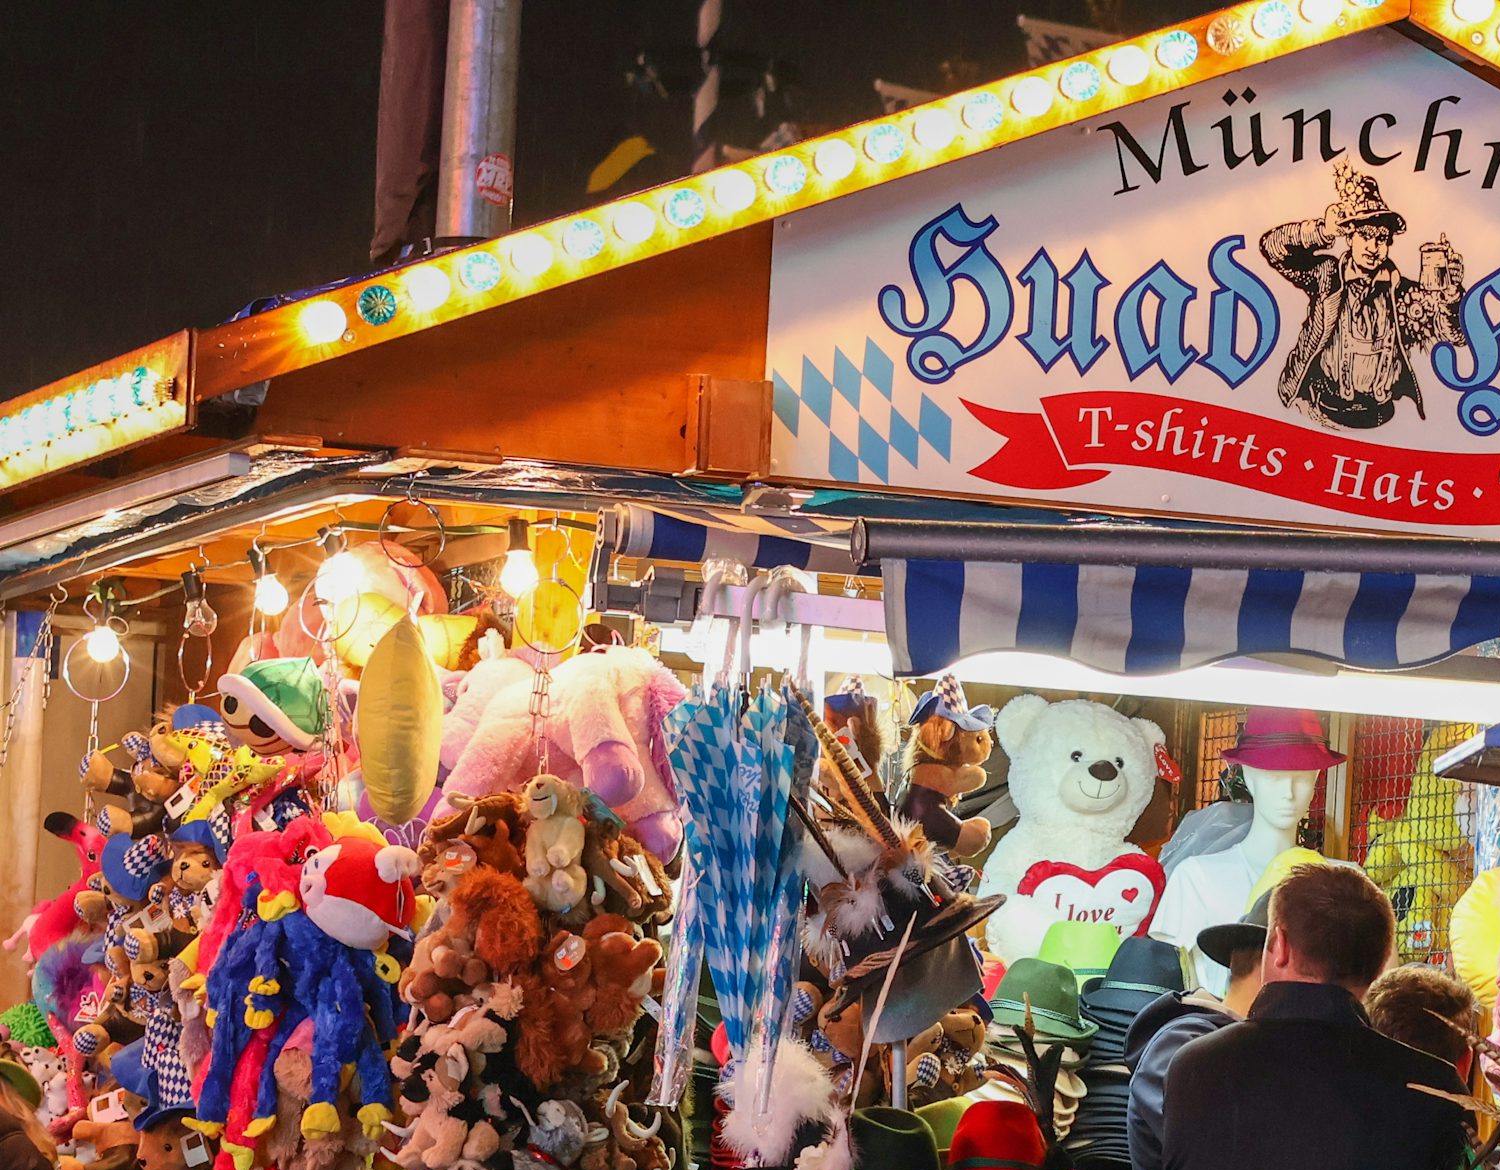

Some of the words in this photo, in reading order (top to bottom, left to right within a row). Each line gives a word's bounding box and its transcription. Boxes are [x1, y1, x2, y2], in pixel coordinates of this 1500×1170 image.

[877, 203, 1280, 390] Huad
[1077, 405, 1287, 477] T-shirts
[1324, 453, 1457, 511] Hats
[1067, 903, 1116, 924] love
